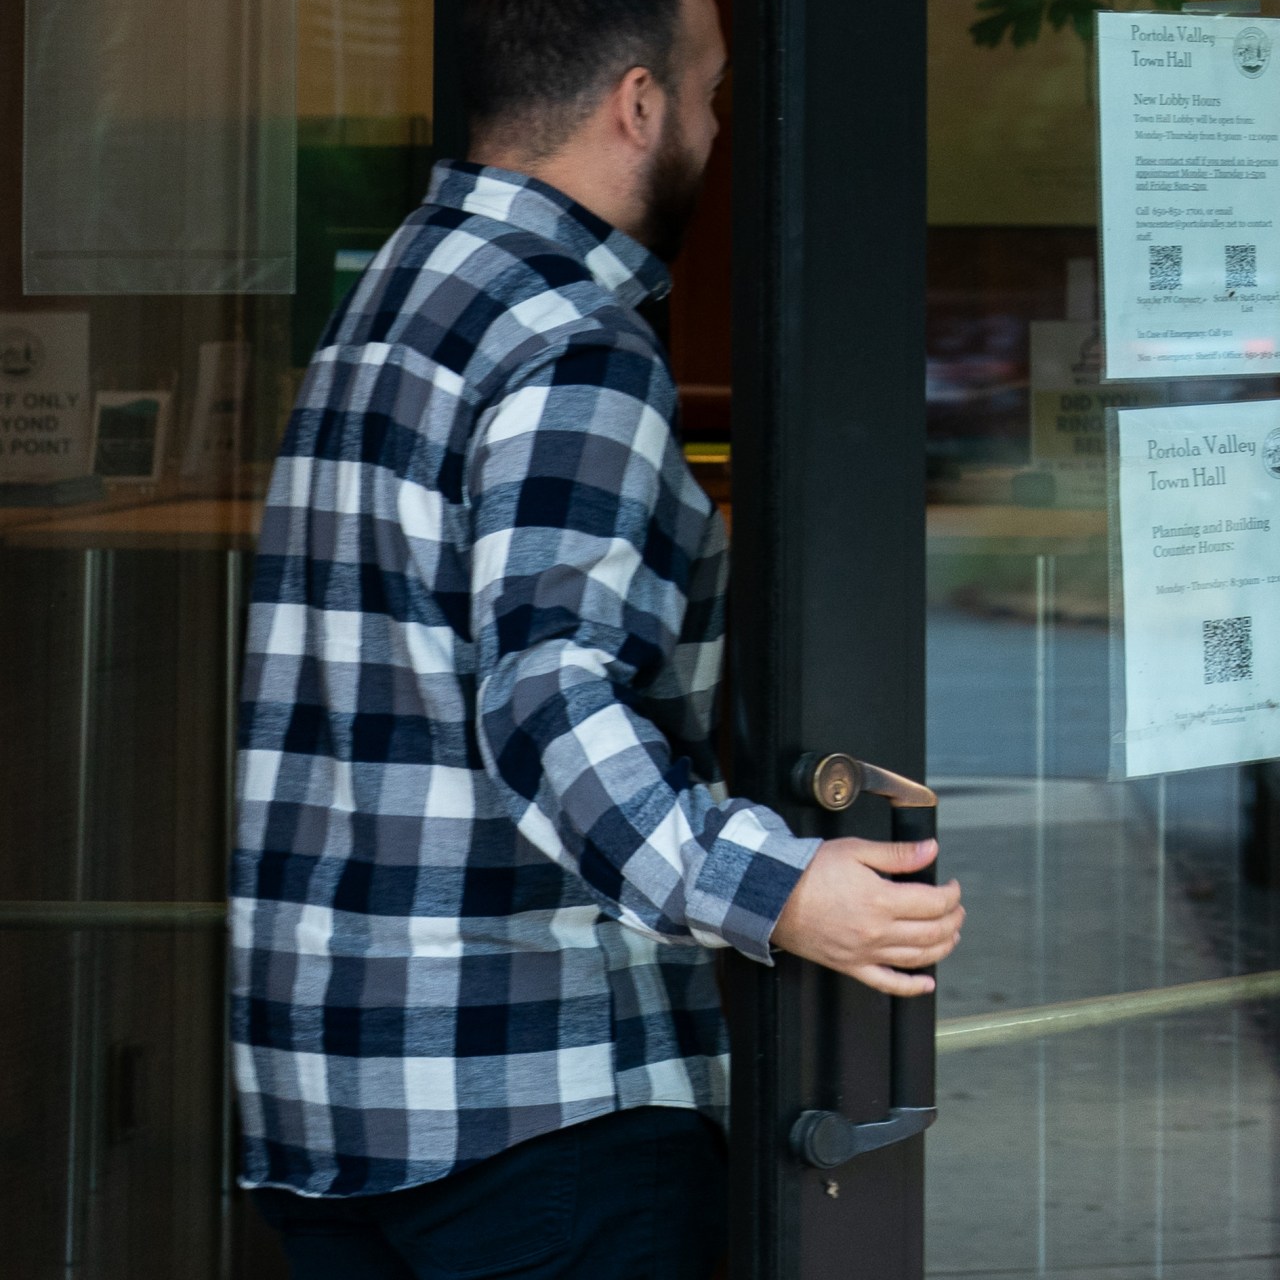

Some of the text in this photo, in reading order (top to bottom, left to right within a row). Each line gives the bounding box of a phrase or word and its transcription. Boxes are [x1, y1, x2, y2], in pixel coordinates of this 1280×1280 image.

[1130, 24, 1217, 47] Portola Valley
[1131, 50, 1192, 68] Town Hall
[1133, 93, 1222, 109] New Lobby Hours
[22, 391, 80, 410] ONLY
[10, 437, 71, 456] POINT
[1147, 437, 1202, 460] Portola
[1202, 434, 1256, 457] Valley
[1148, 465, 1227, 491] Town Hall
[1152, 517, 1271, 539] Planning and Building
[1152, 541, 1235, 558] Counter Hours:
[1229, 577, 1260, 588] 8:30am
